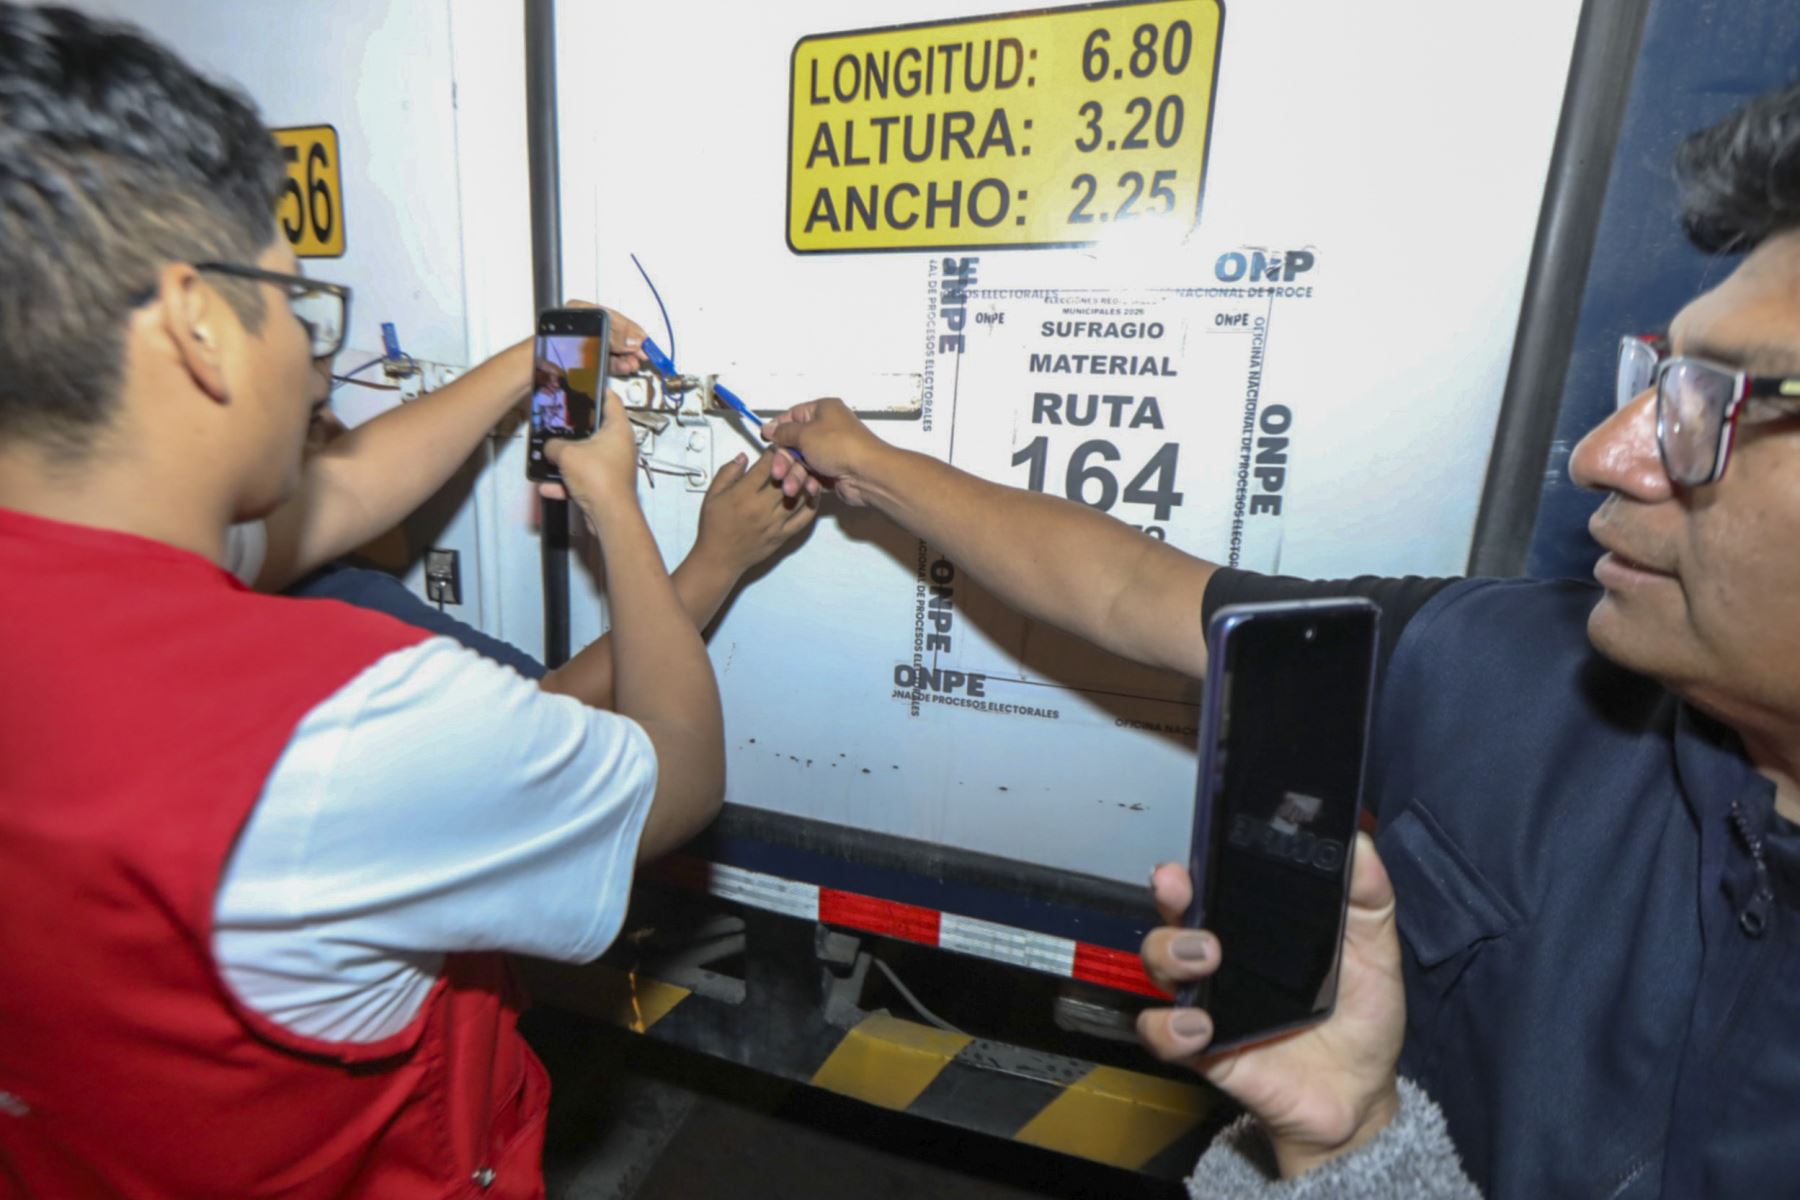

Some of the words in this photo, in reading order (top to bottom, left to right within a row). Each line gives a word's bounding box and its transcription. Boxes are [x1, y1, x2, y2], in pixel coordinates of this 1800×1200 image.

[810, 37, 1037, 105] LONGITUD:
[1081, 20, 1192, 82] 6.80
[806, 107, 1033, 168] ALTURA:
[1075, 94, 1185, 153] 3.20
[804, 177, 1028, 233] ANCHO:
[1066, 169, 1177, 224] 2.25
[925, 297, 937, 359] PROCESOS
[975, 312, 1004, 325] ONPE
[1040, 321, 1165, 339] SUFRAGIO
[1062, 307, 1121, 316] MUNICIPALES
[1215, 313, 1249, 327] ONPE
[1029, 353, 1178, 377] MATERIAL
[922, 359, 935, 432] ELECTORALES
[1031, 391, 1165, 430] RUTA
[1242, 370, 1261, 435] NACIONAL
[1011, 435, 1184, 521] 164
[1249, 403, 1292, 516] ONPE
[914, 599, 926, 653] PROCESOS
[926, 559, 954, 653] ONPE
[893, 664, 987, 698] ONPE
[932, 694, 987, 711] PROCESOS
[988, 702, 1060, 719] ELECTORALES
